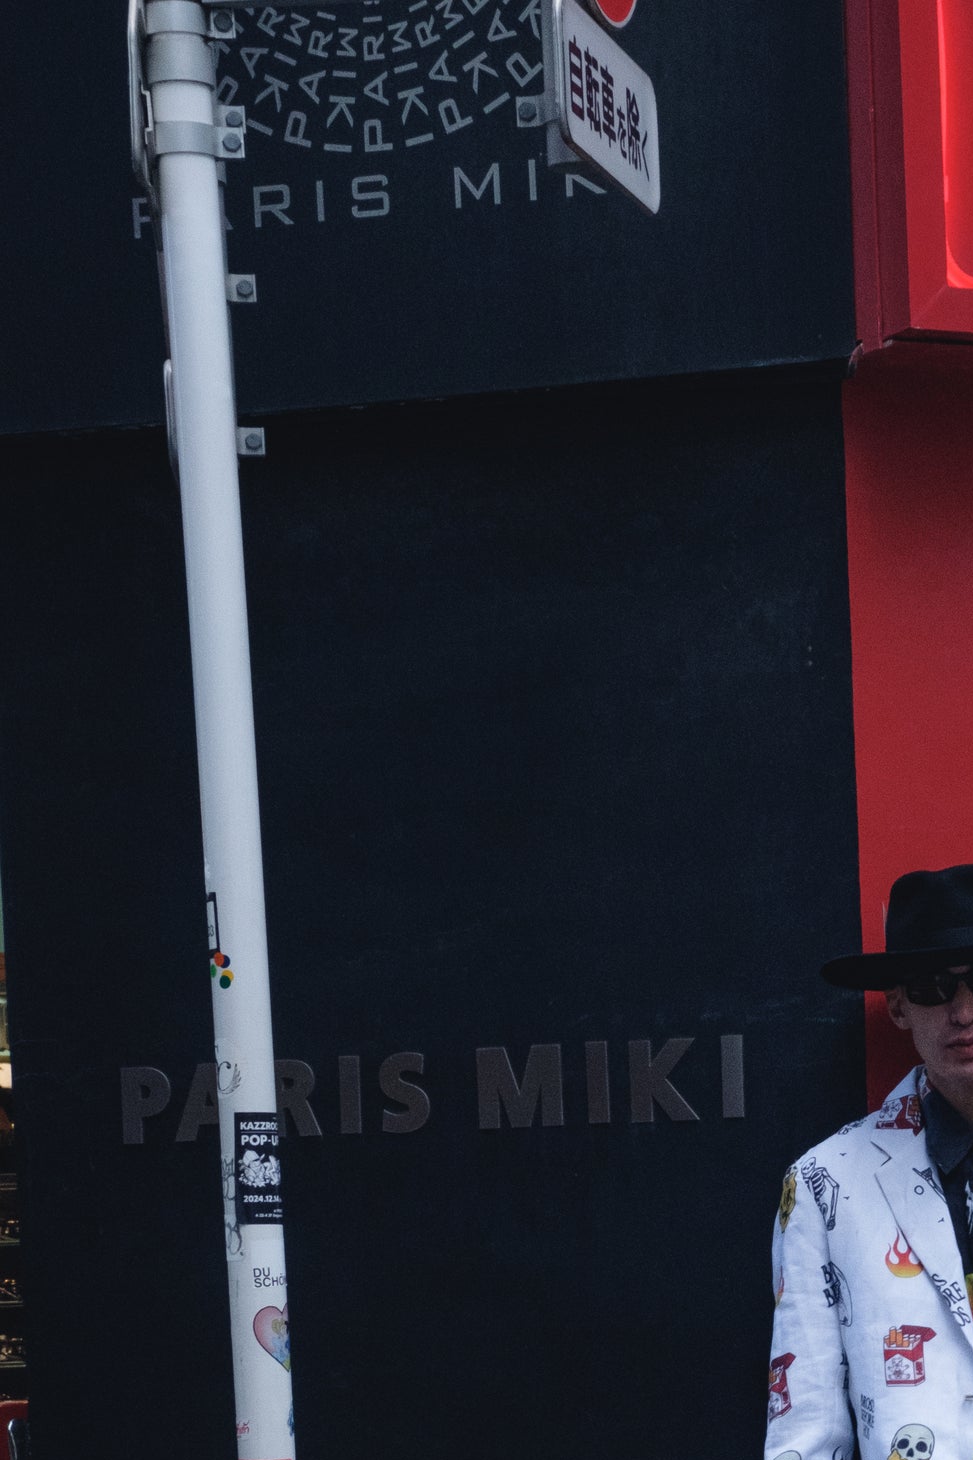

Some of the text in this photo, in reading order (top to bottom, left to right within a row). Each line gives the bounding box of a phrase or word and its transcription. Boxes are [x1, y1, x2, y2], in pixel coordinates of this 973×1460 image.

[362, 0, 393, 152] PARI
[569, 35, 649, 182] 自転車を除く
[132, 174, 390, 239] PRIS
[475, 1034, 745, 1128] MIKI
